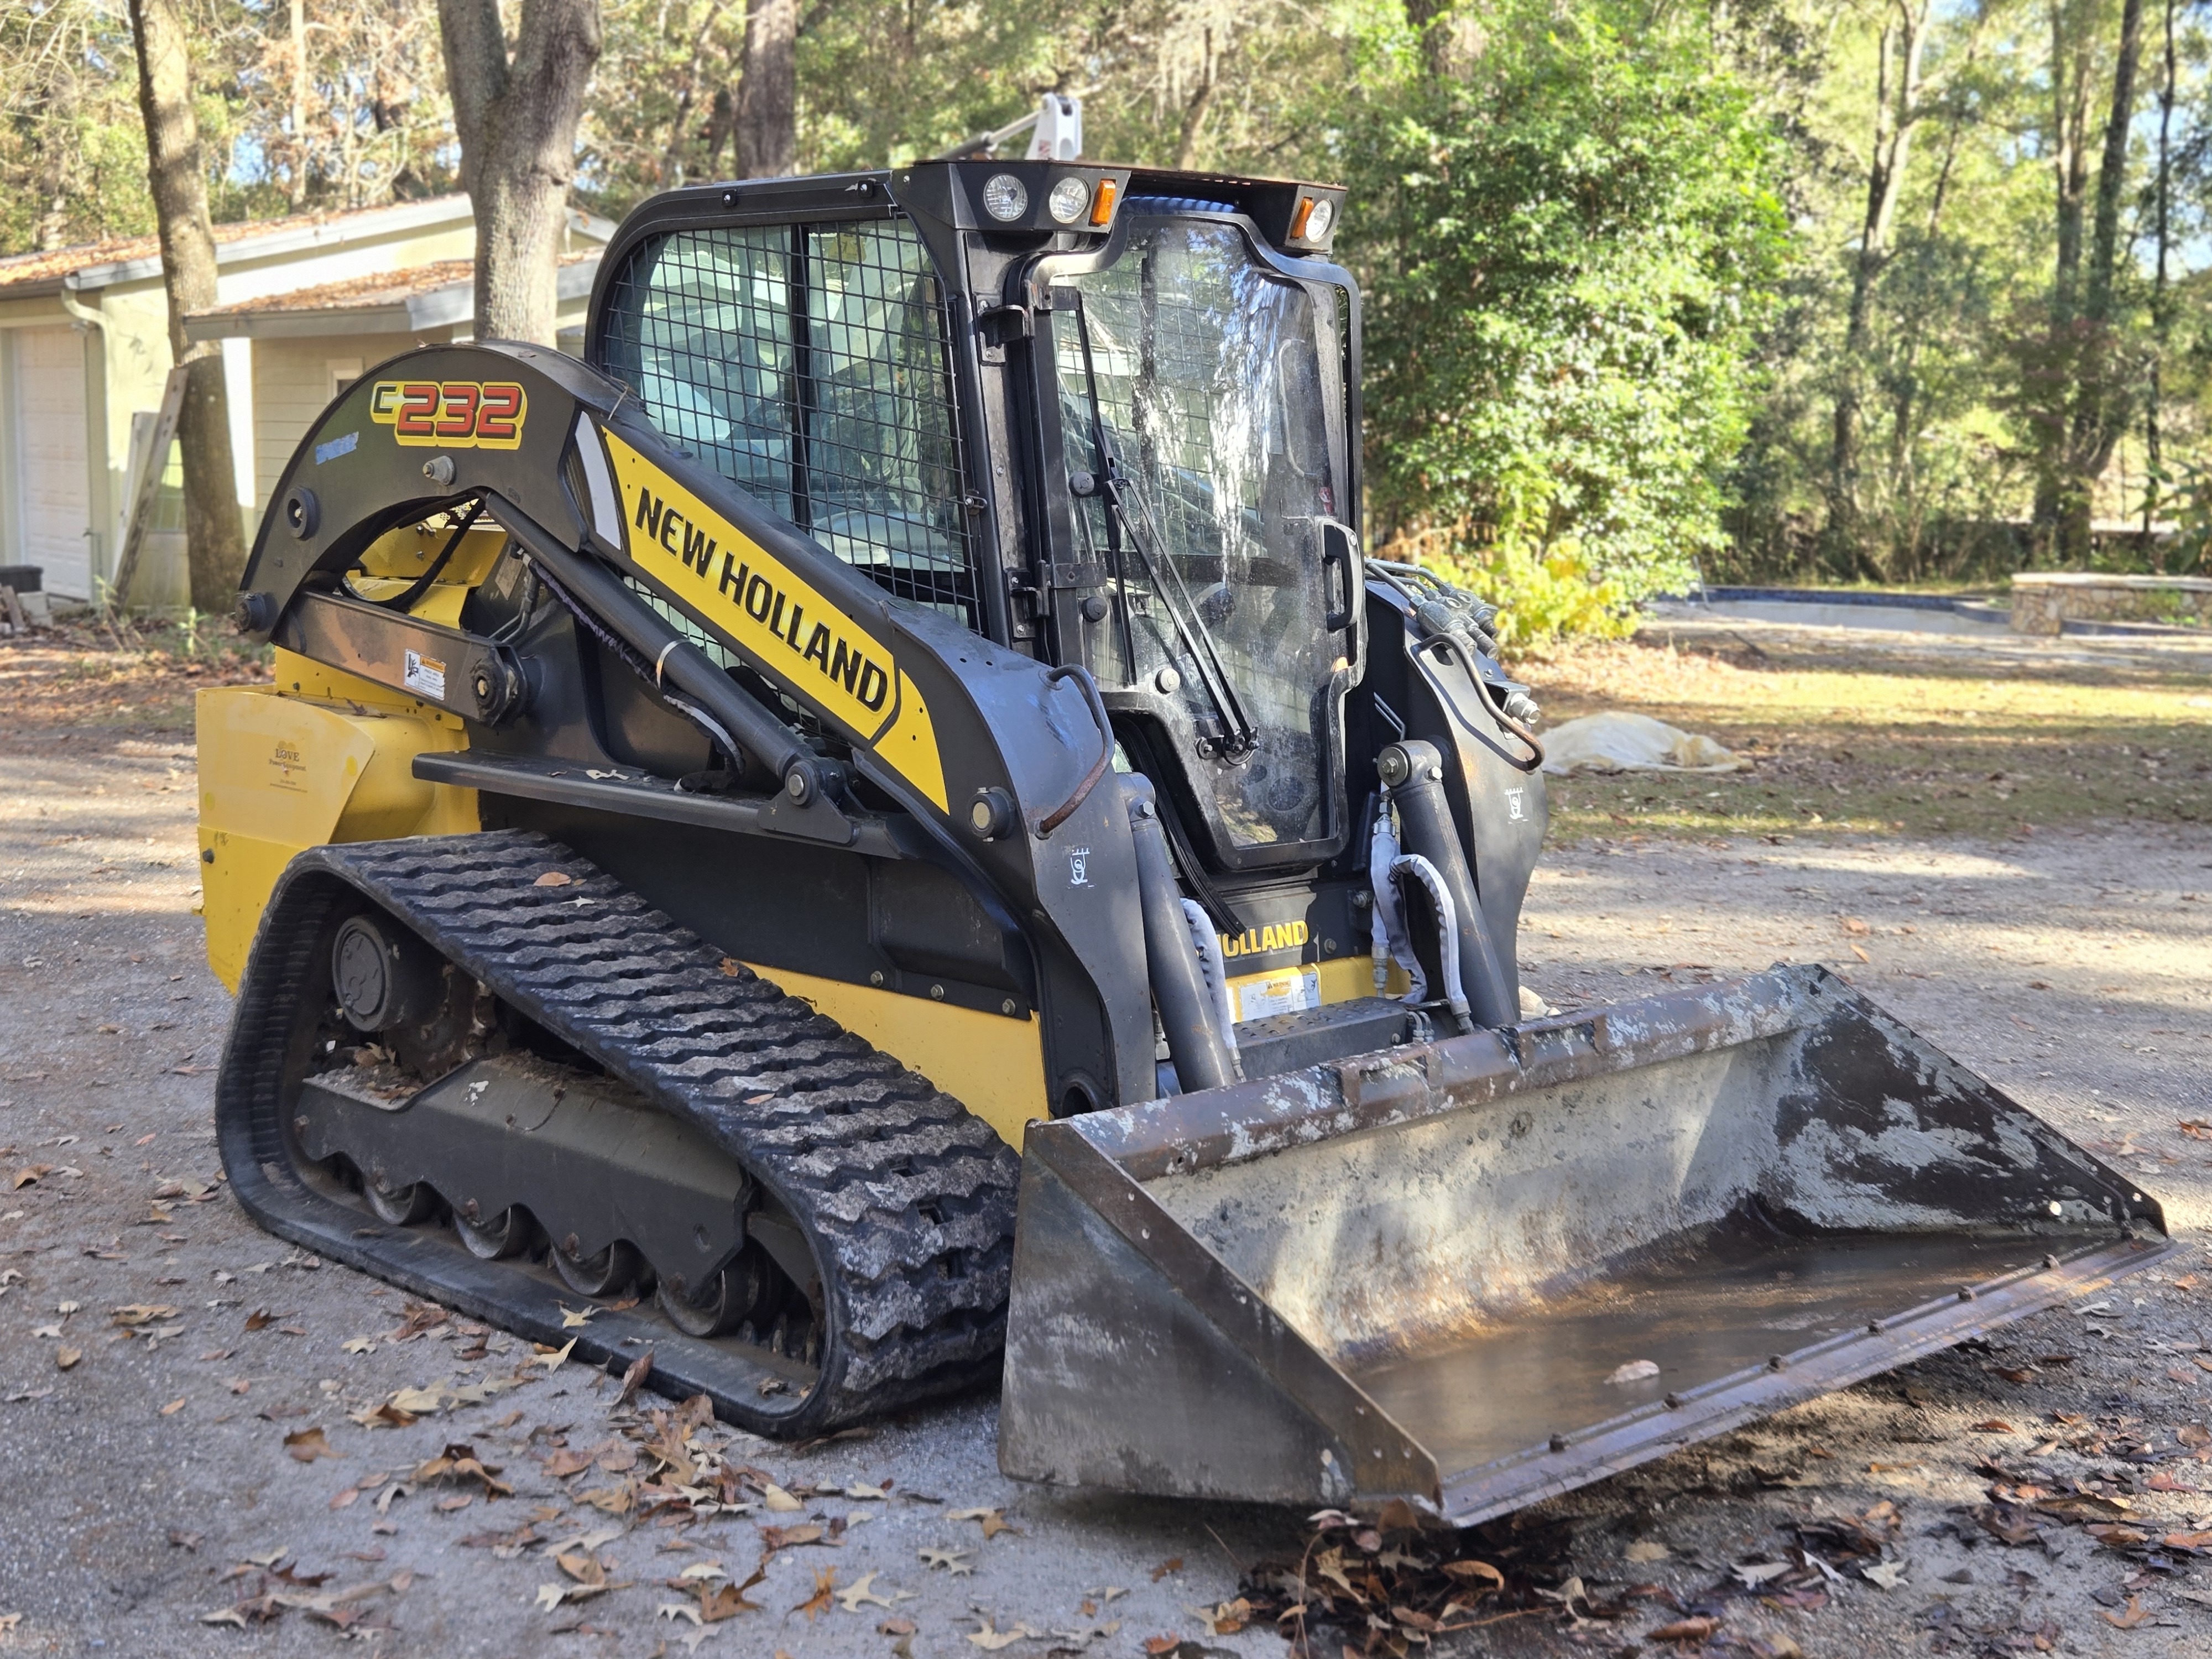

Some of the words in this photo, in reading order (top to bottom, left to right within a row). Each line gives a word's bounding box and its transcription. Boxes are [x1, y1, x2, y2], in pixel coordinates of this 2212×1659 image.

[372, 383, 523, 444] C232
[635, 486, 717, 579] NEW
[718, 551, 888, 712] HOLLAND
[275, 748, 299, 762] LOVE
